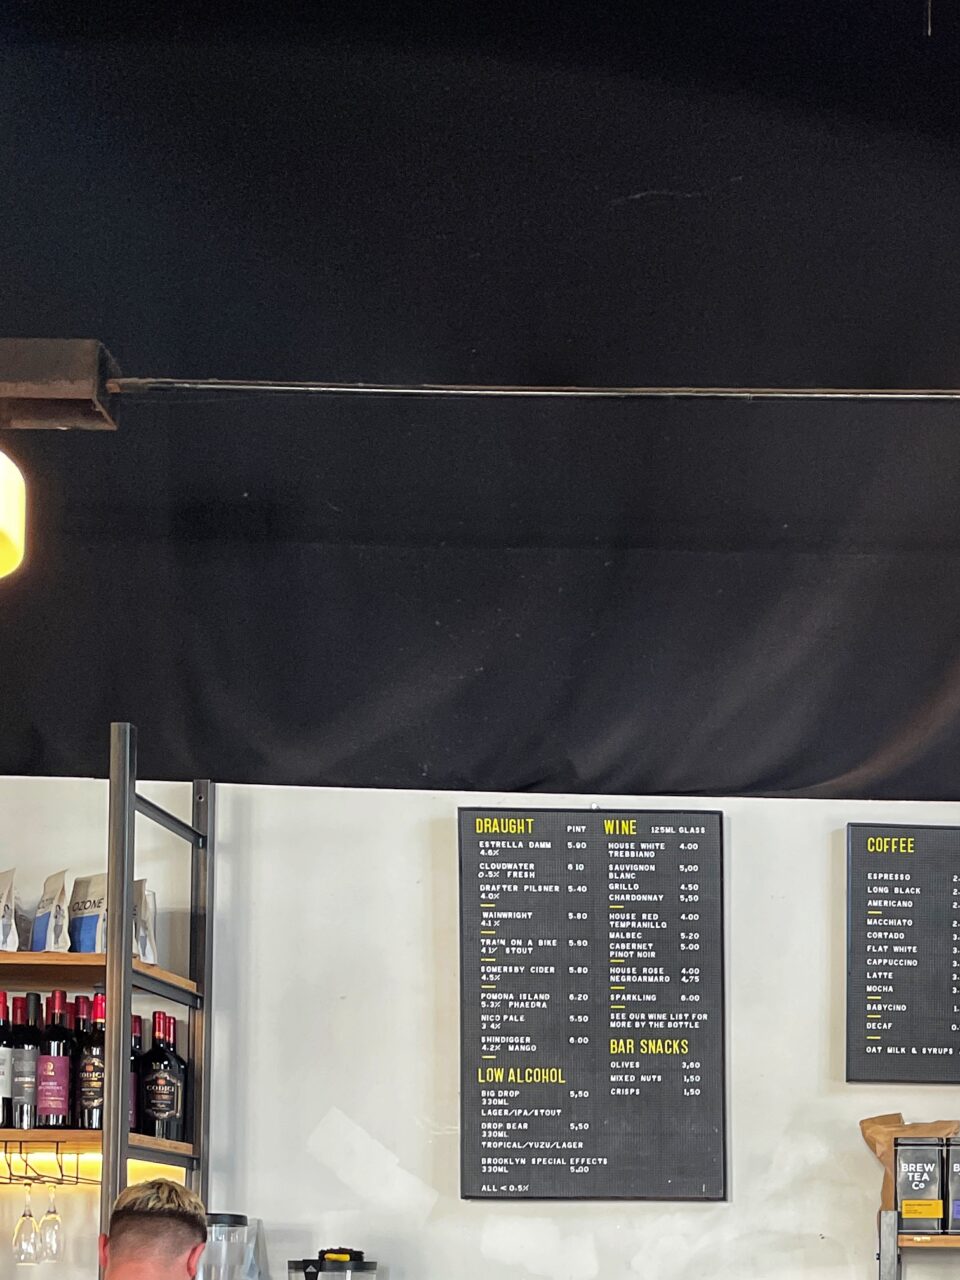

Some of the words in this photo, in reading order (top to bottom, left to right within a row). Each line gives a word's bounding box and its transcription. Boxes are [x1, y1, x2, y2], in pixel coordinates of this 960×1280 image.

[476, 818, 534, 834] DRAUGHT
[604, 820, 637, 835] WINE
[868, 837, 914, 853] COFFEE
[608, 850, 655, 858] TREBBIANO
[480, 884, 518, 892] DRAFTER
[72, 898, 104, 912] OZONE
[867, 918, 913, 926] MACCHIATO
[867, 958, 918, 966] CAPPUCCINO
[610, 1039, 634, 1054] BAR
[640, 1039, 688, 1054] SNACKS
[478, 1068, 504, 1083] LOW
[508, 1068, 566, 1083] ALCOHOL
[901, 1163, 935, 1173] BREW
[907, 1172, 930, 1182] TEA
